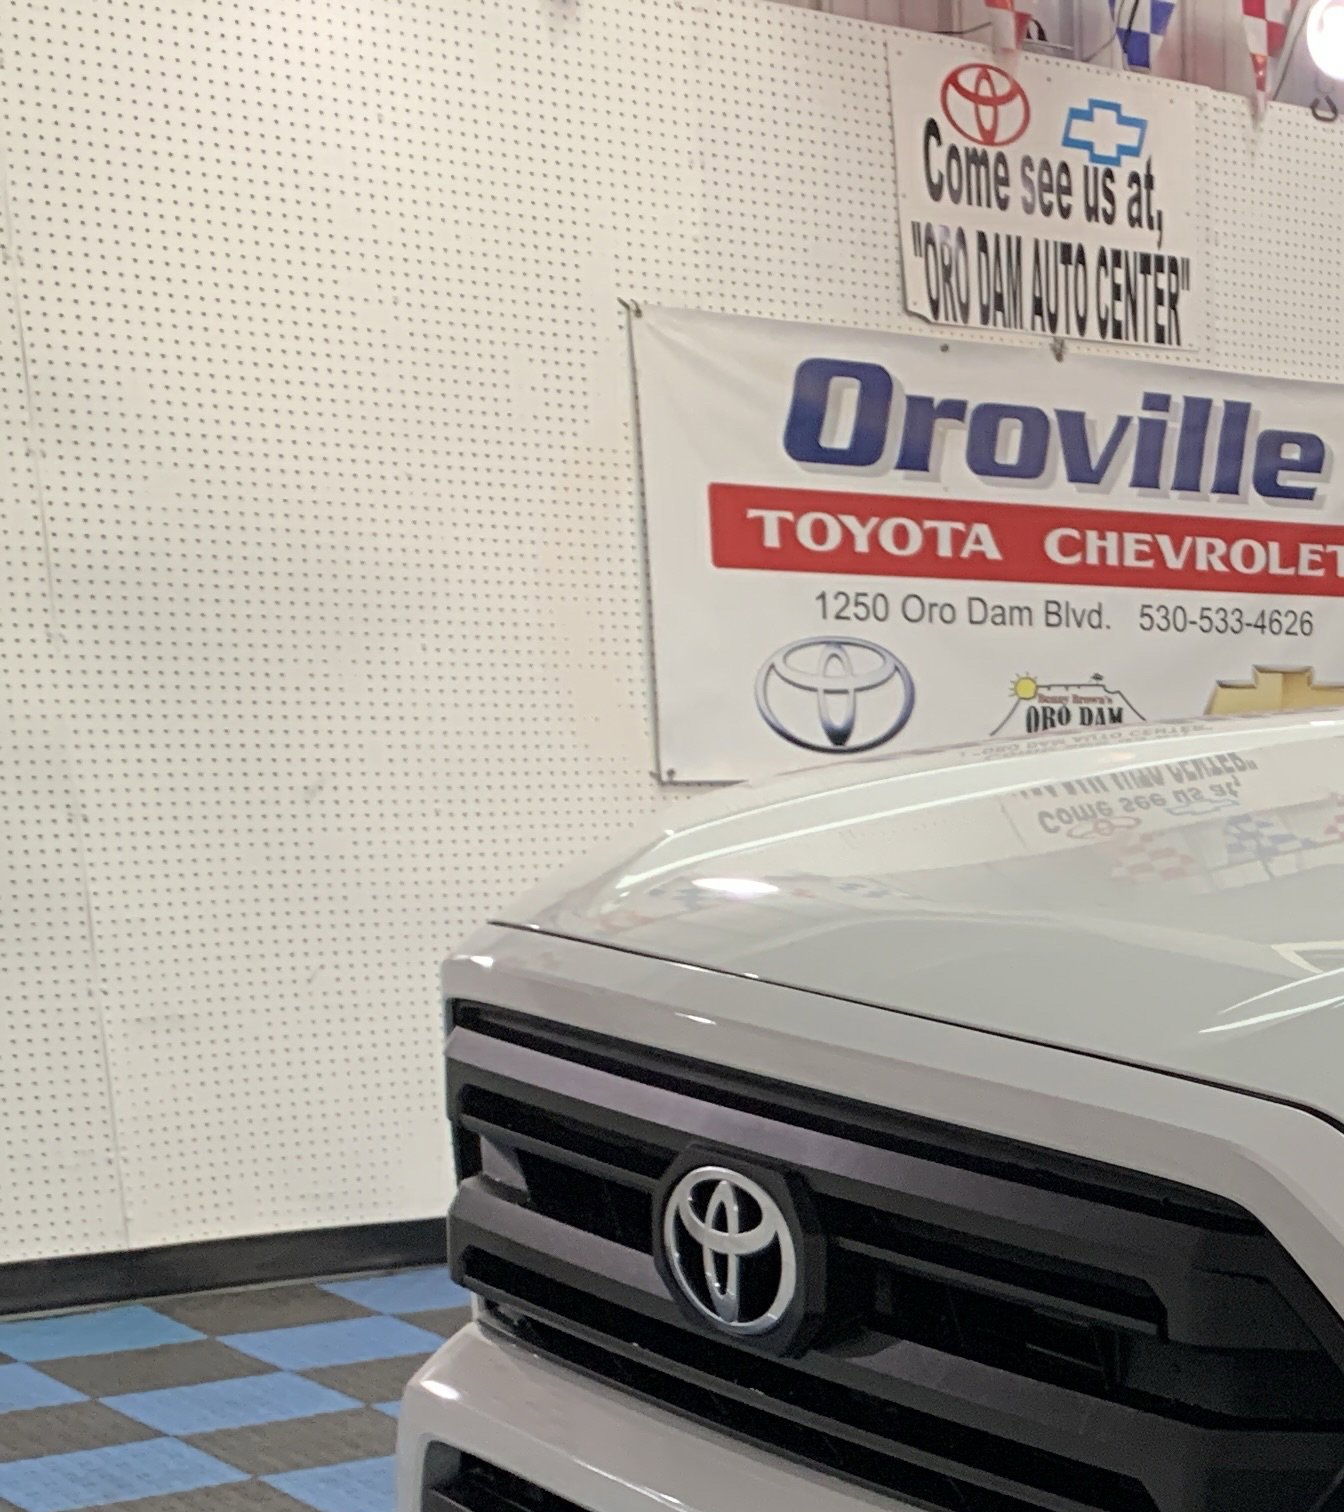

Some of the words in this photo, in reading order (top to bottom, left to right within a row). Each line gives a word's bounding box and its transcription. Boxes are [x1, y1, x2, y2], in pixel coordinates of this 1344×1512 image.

[923, 117, 1010, 211] Come
[1020, 154, 1072, 220] see
[1083, 165, 1116, 225] us
[1127, 154, 1163, 250] at,
[910, 221, 970, 324] "ORO
[976, 230, 1024, 330] DAM
[1031, 238, 1088, 337] AUTO
[1096, 245, 1190, 347] CENTER"
[783, 357, 1328, 502] Oroville
[746, 508, 1002, 561] TOYOTA
[815, 592, 889, 622] 1250
[901, 594, 956, 624] Oro
[968, 597, 1033, 627] Dam
[1044, 600, 1111, 630] Blvd.
[1138, 604, 1314, 637] 530-533-4626
[1026, 705, 1071, 733] ORO
[1080, 706, 1123, 726] DAM
